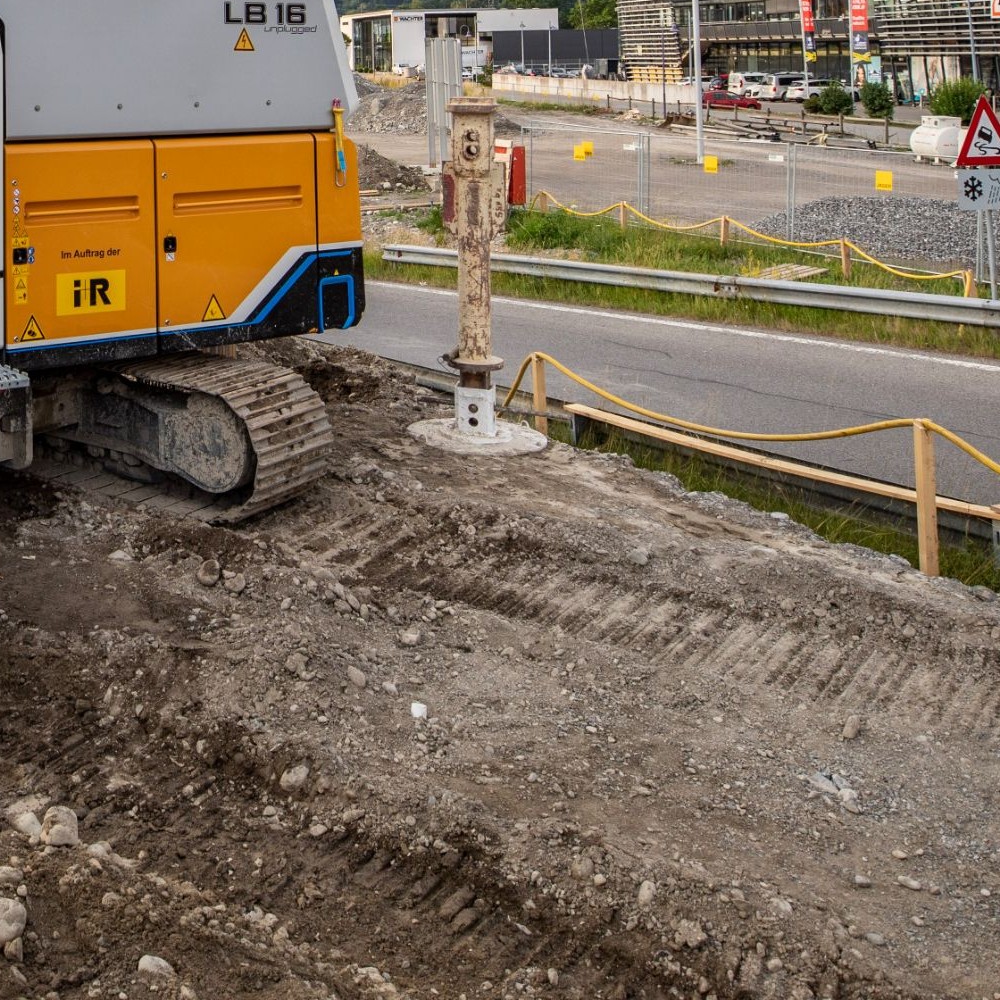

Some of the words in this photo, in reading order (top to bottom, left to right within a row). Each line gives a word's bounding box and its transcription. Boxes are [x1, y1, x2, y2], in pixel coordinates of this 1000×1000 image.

[224, 1, 266, 24] LB
[276, 3, 306, 25] 16
[264, 25, 317, 34] unplugged
[61, 251, 72, 259] Im
[74, 249, 105, 258] Auftrag
[107, 248, 121, 256] der
